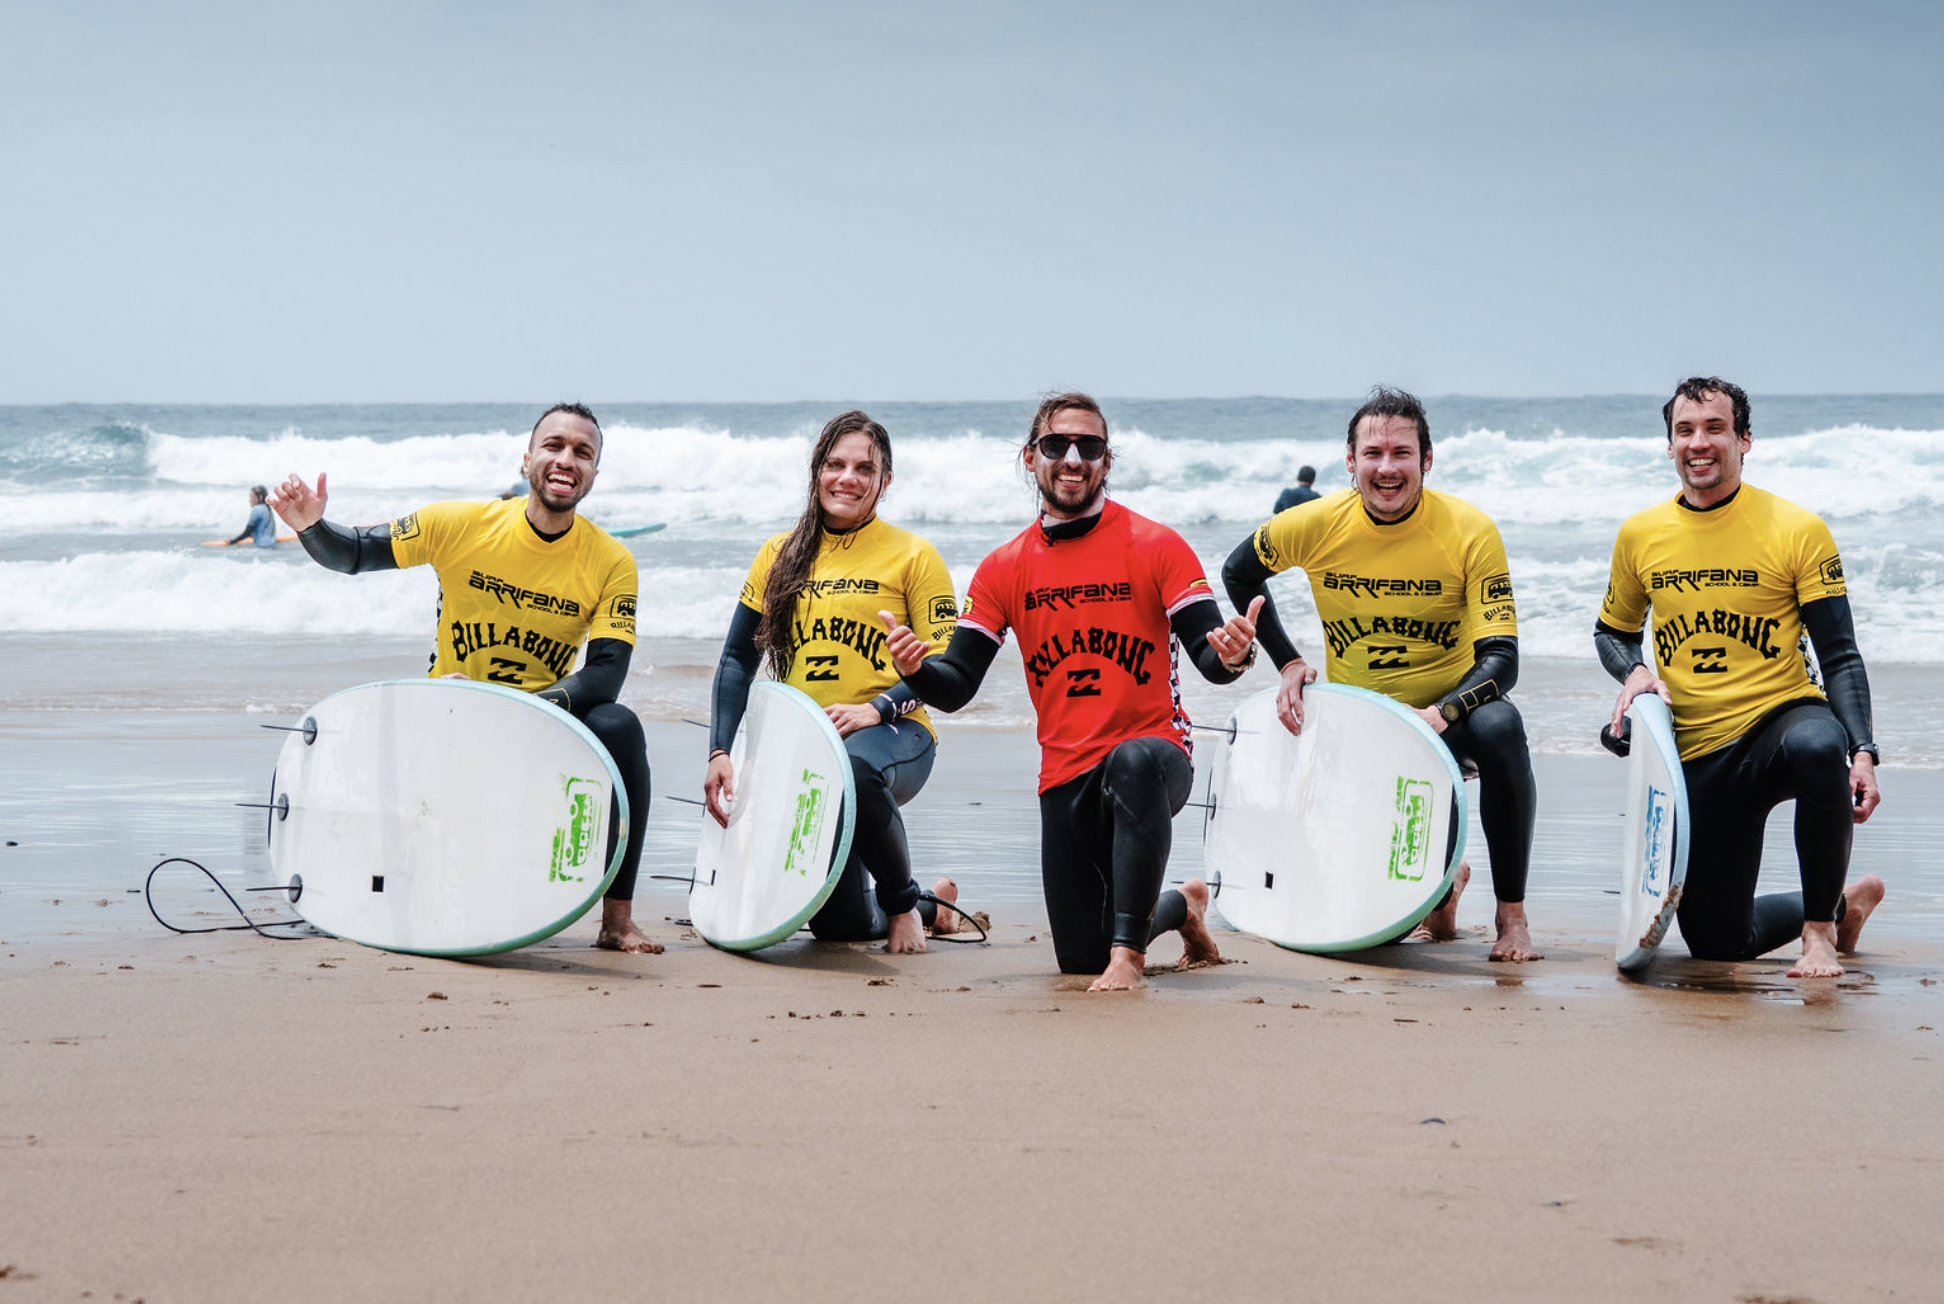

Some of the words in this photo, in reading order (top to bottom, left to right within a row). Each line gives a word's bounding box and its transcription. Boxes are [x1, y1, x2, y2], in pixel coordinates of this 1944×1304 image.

[527, 603, 553, 613] SCHOOL
[452, 620, 579, 680] BILLABONG
[1322, 616, 1461, 659] BILLABONG
[1655, 608, 1781, 667] BILLABONG
